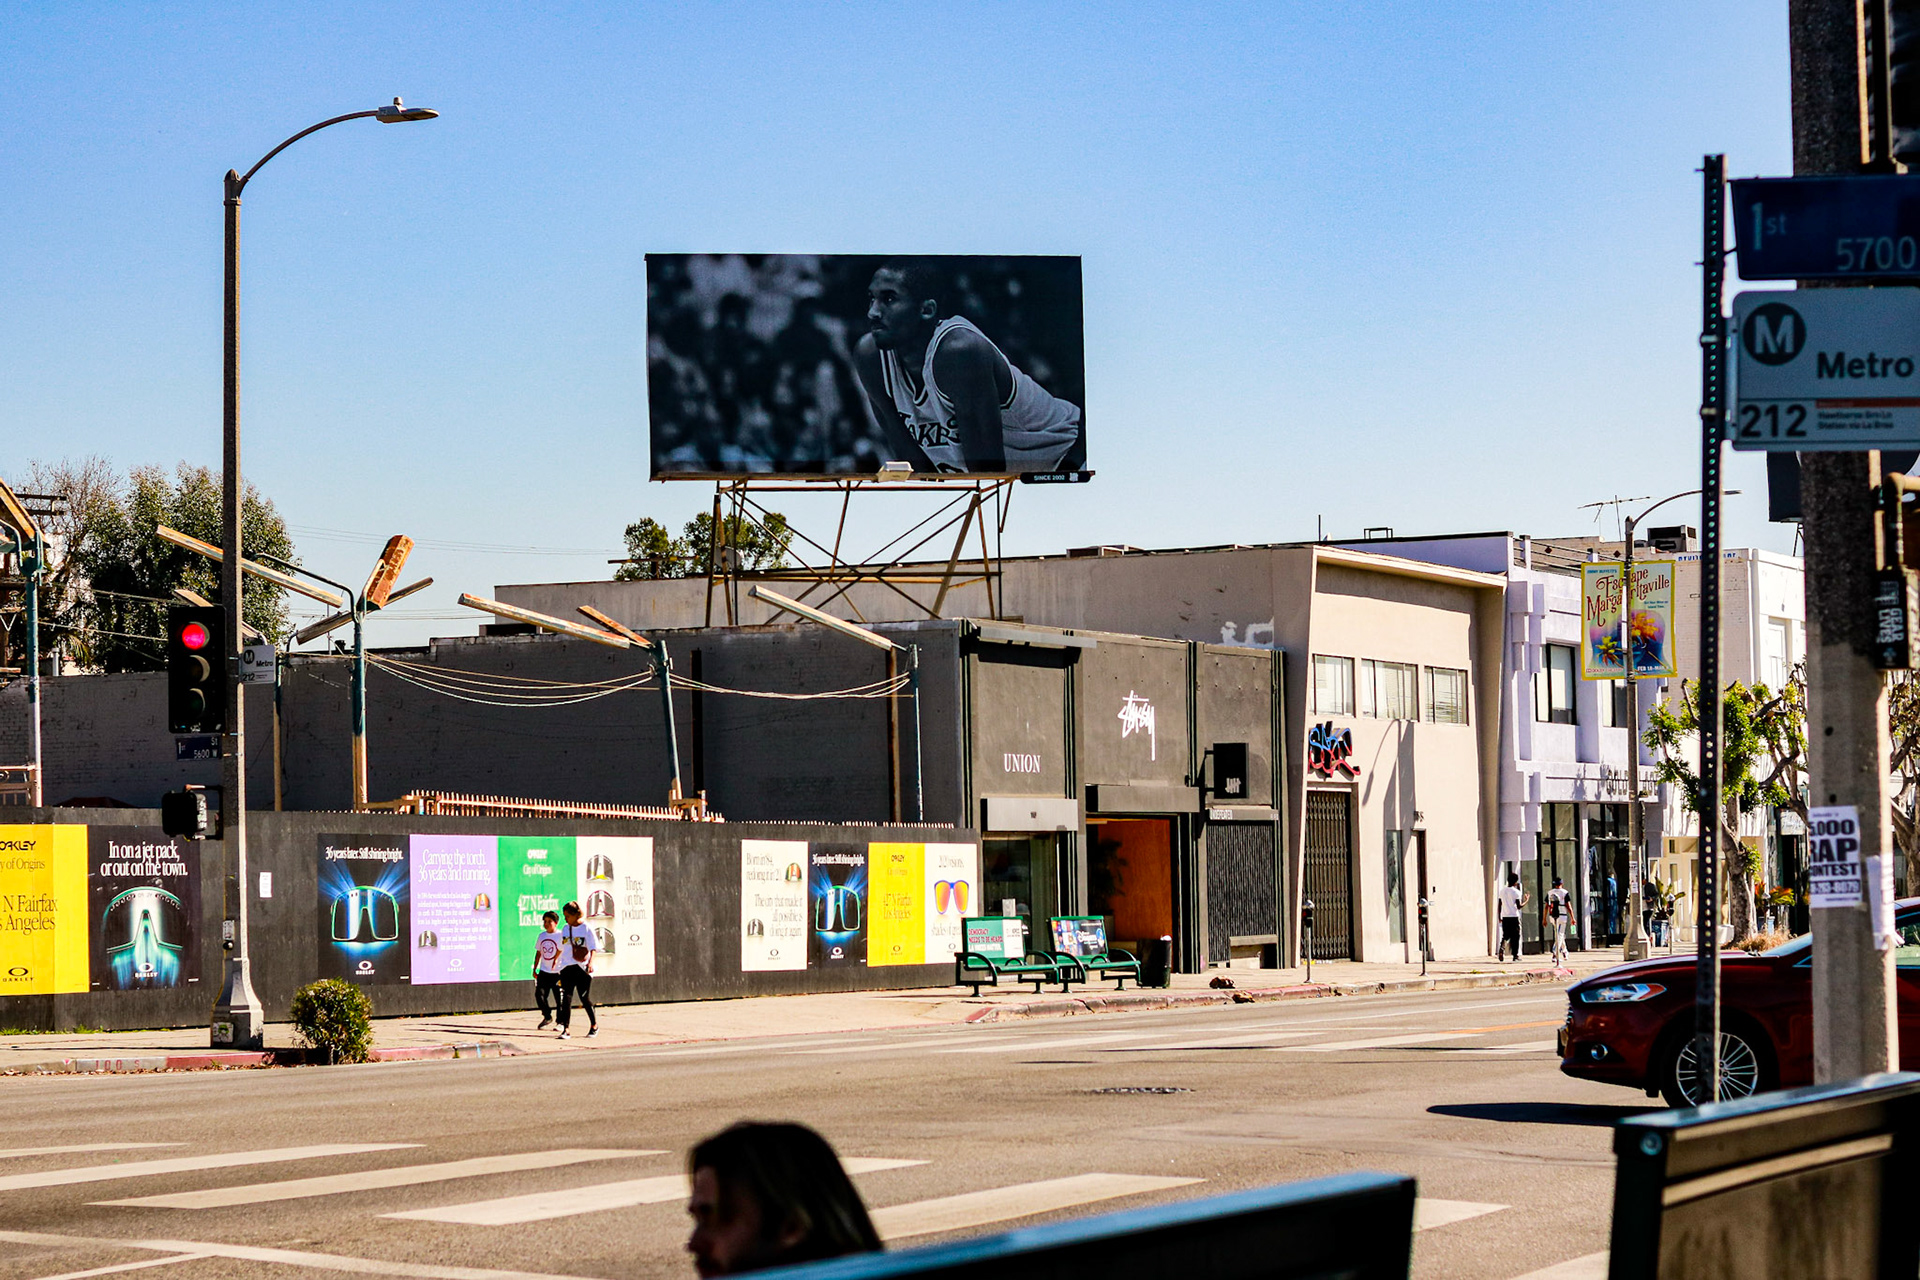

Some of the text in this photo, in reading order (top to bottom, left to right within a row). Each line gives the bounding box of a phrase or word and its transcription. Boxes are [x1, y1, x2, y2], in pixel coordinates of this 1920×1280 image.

[1752, 202, 1787, 250] 1st
[1837, 236, 1917, 271] 5700
[1816, 351, 1915, 379] Metro
[1740, 404, 1808, 438] 212
[1033, 474, 1051, 482] SINCE
[1878, 608, 1893, 644] LIVES
[1890, 608, 1905, 641] GEAR
[256, 660, 274, 668] Metro
[242, 673, 256, 682] 212
[193, 749, 210, 759] 5600
[1003, 753, 1042, 773] UNION
[0, 840, 37, 851] OAKLEY
[108, 840, 180, 863] In on a jet pack,
[325, 846, 333, 860] 36
[6, 859, 15, 870] of
[16, 858, 46, 872] Origins
[100, 859, 188, 876] or out on the town.
[422, 848, 487, 869] Carrying the torch.
[418, 864, 428, 883] 36
[428, 869, 447, 885] years
[447, 864, 462, 881] and
[3, 893, 58, 912] N Fairfax
[517, 894, 560, 911] 427 N Fairfax
[5, 912, 56, 936] Angeles
[519, 911, 532, 926] Los
[968, 928, 989, 936] DEMOCRACY
